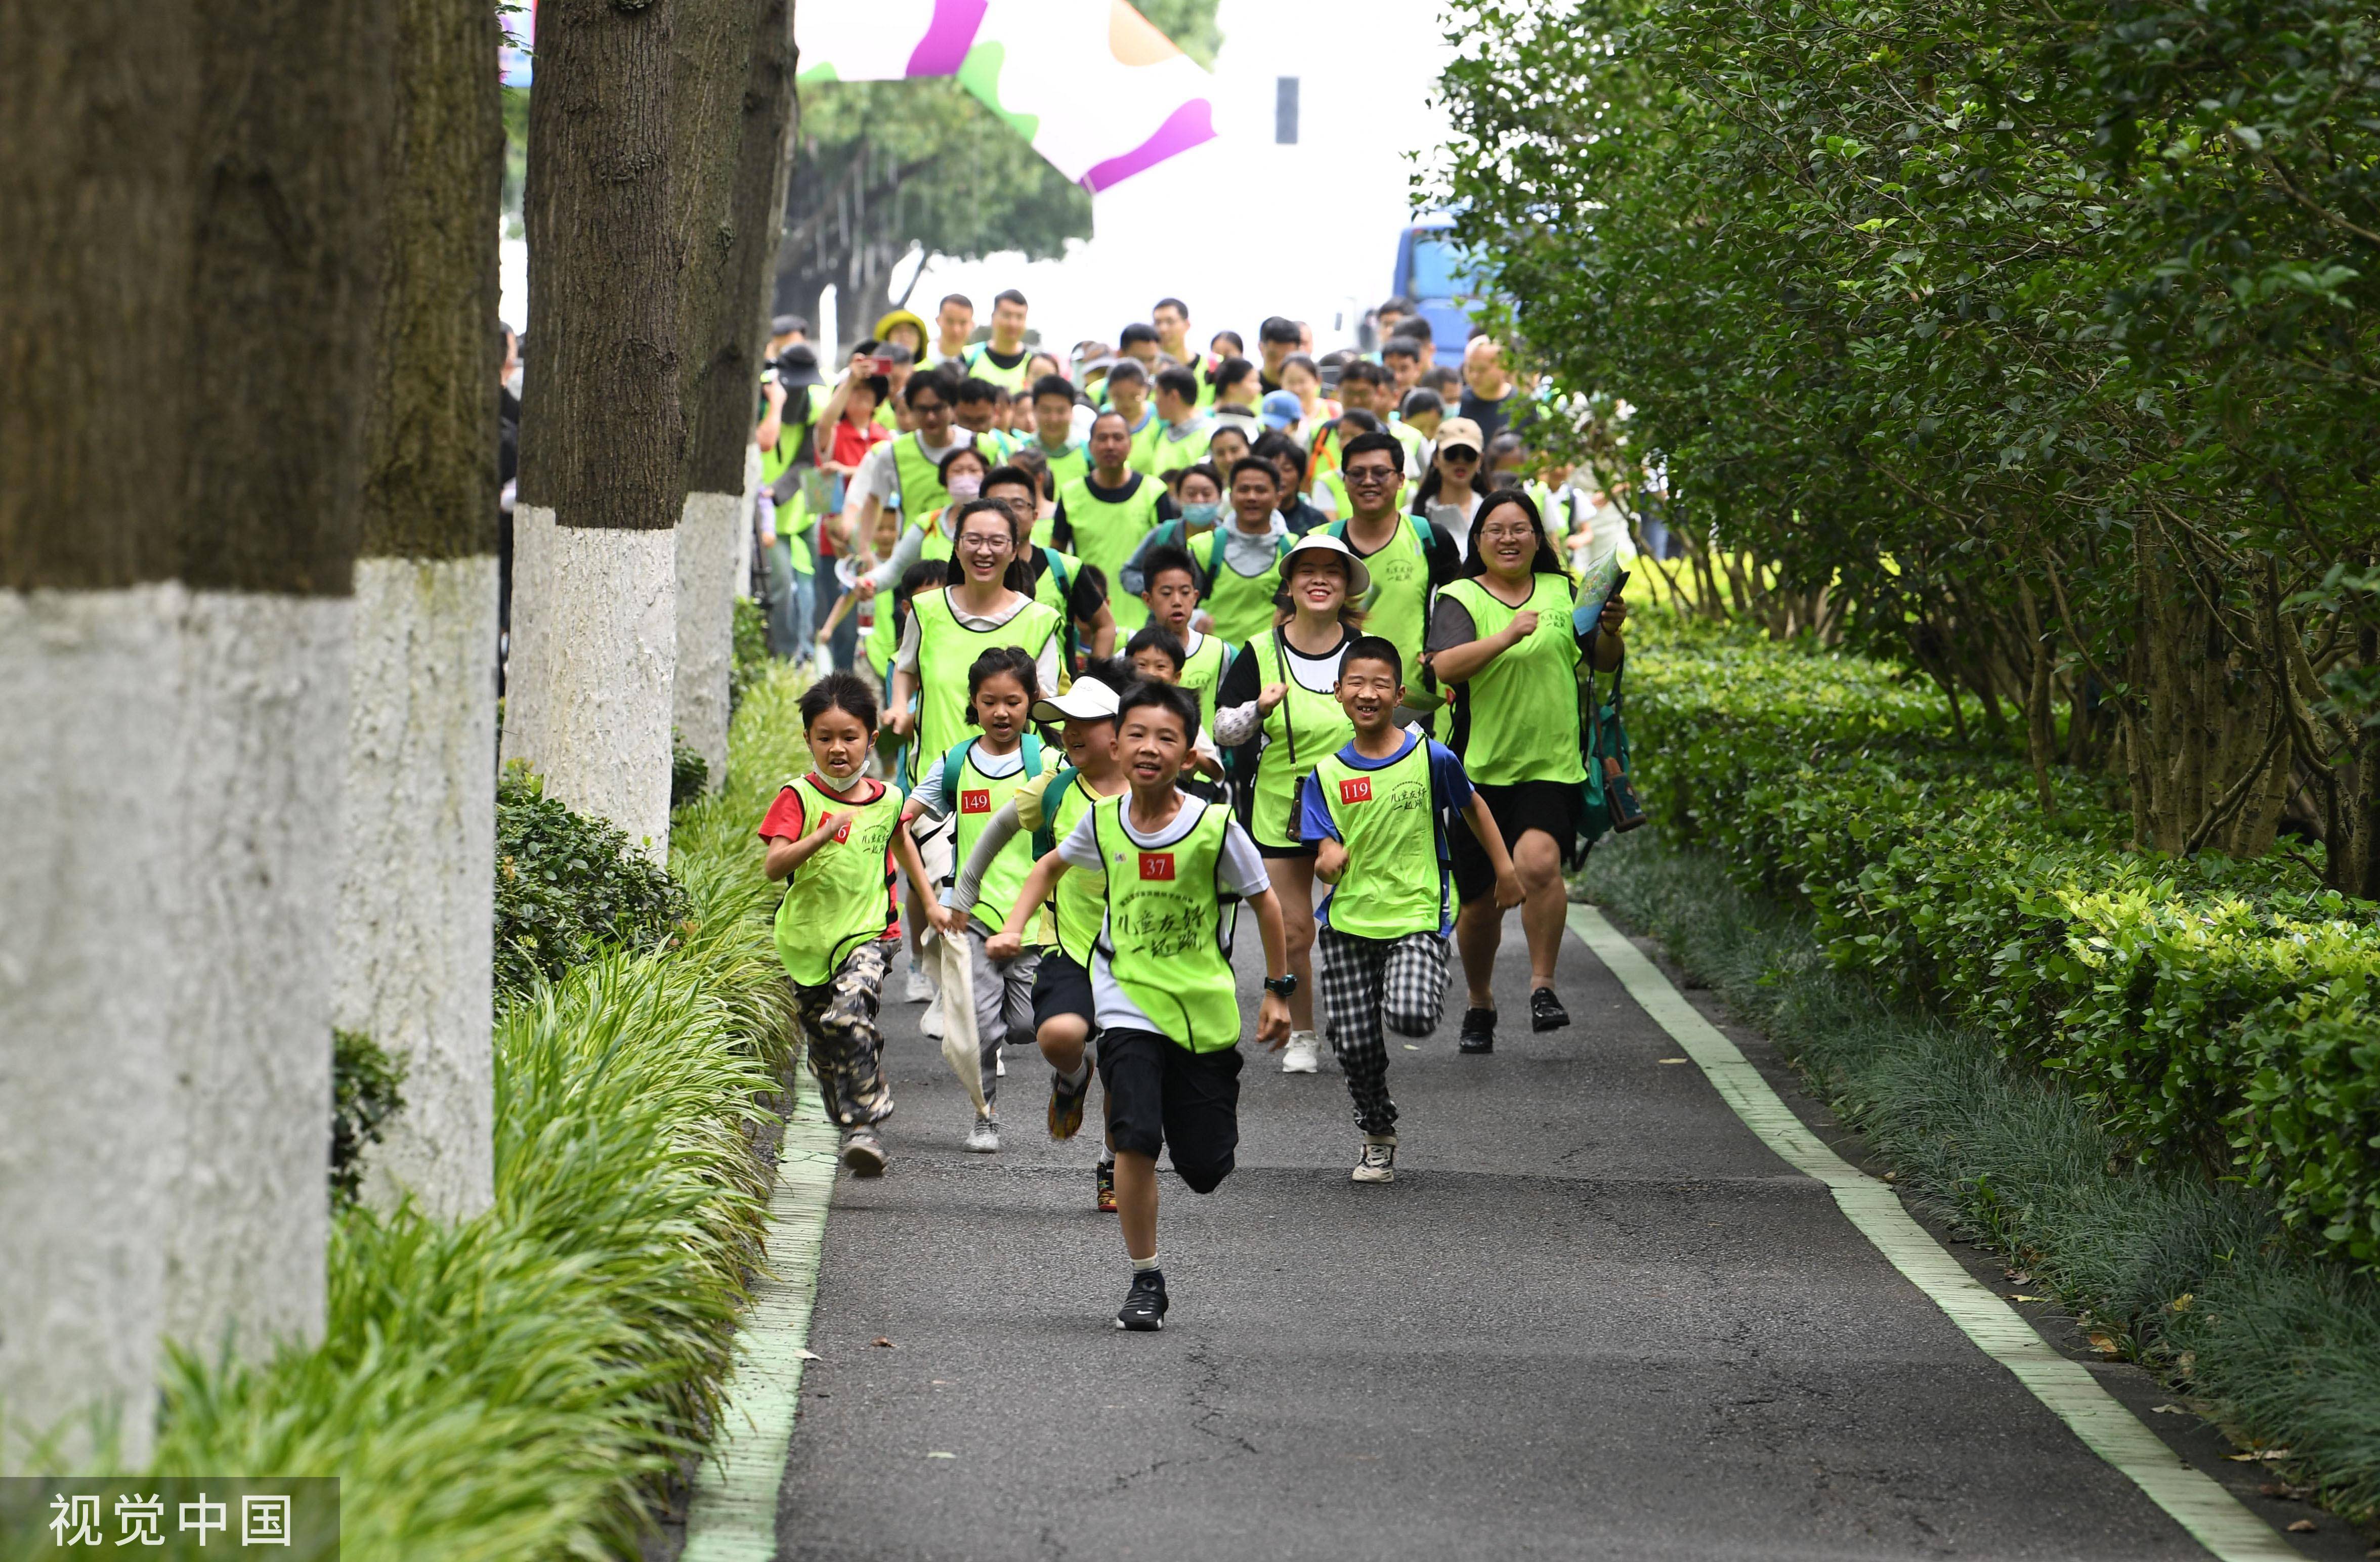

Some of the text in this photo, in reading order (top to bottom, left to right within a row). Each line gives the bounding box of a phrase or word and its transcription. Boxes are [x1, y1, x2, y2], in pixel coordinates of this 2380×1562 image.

[1343, 783, 1368, 799] 119
[1391, 788, 1427, 803] 儿童友好
[964, 795, 987, 809] 149
[1146, 858, 1166, 876] 37
[1118, 905, 1205, 935] 儿童友好
